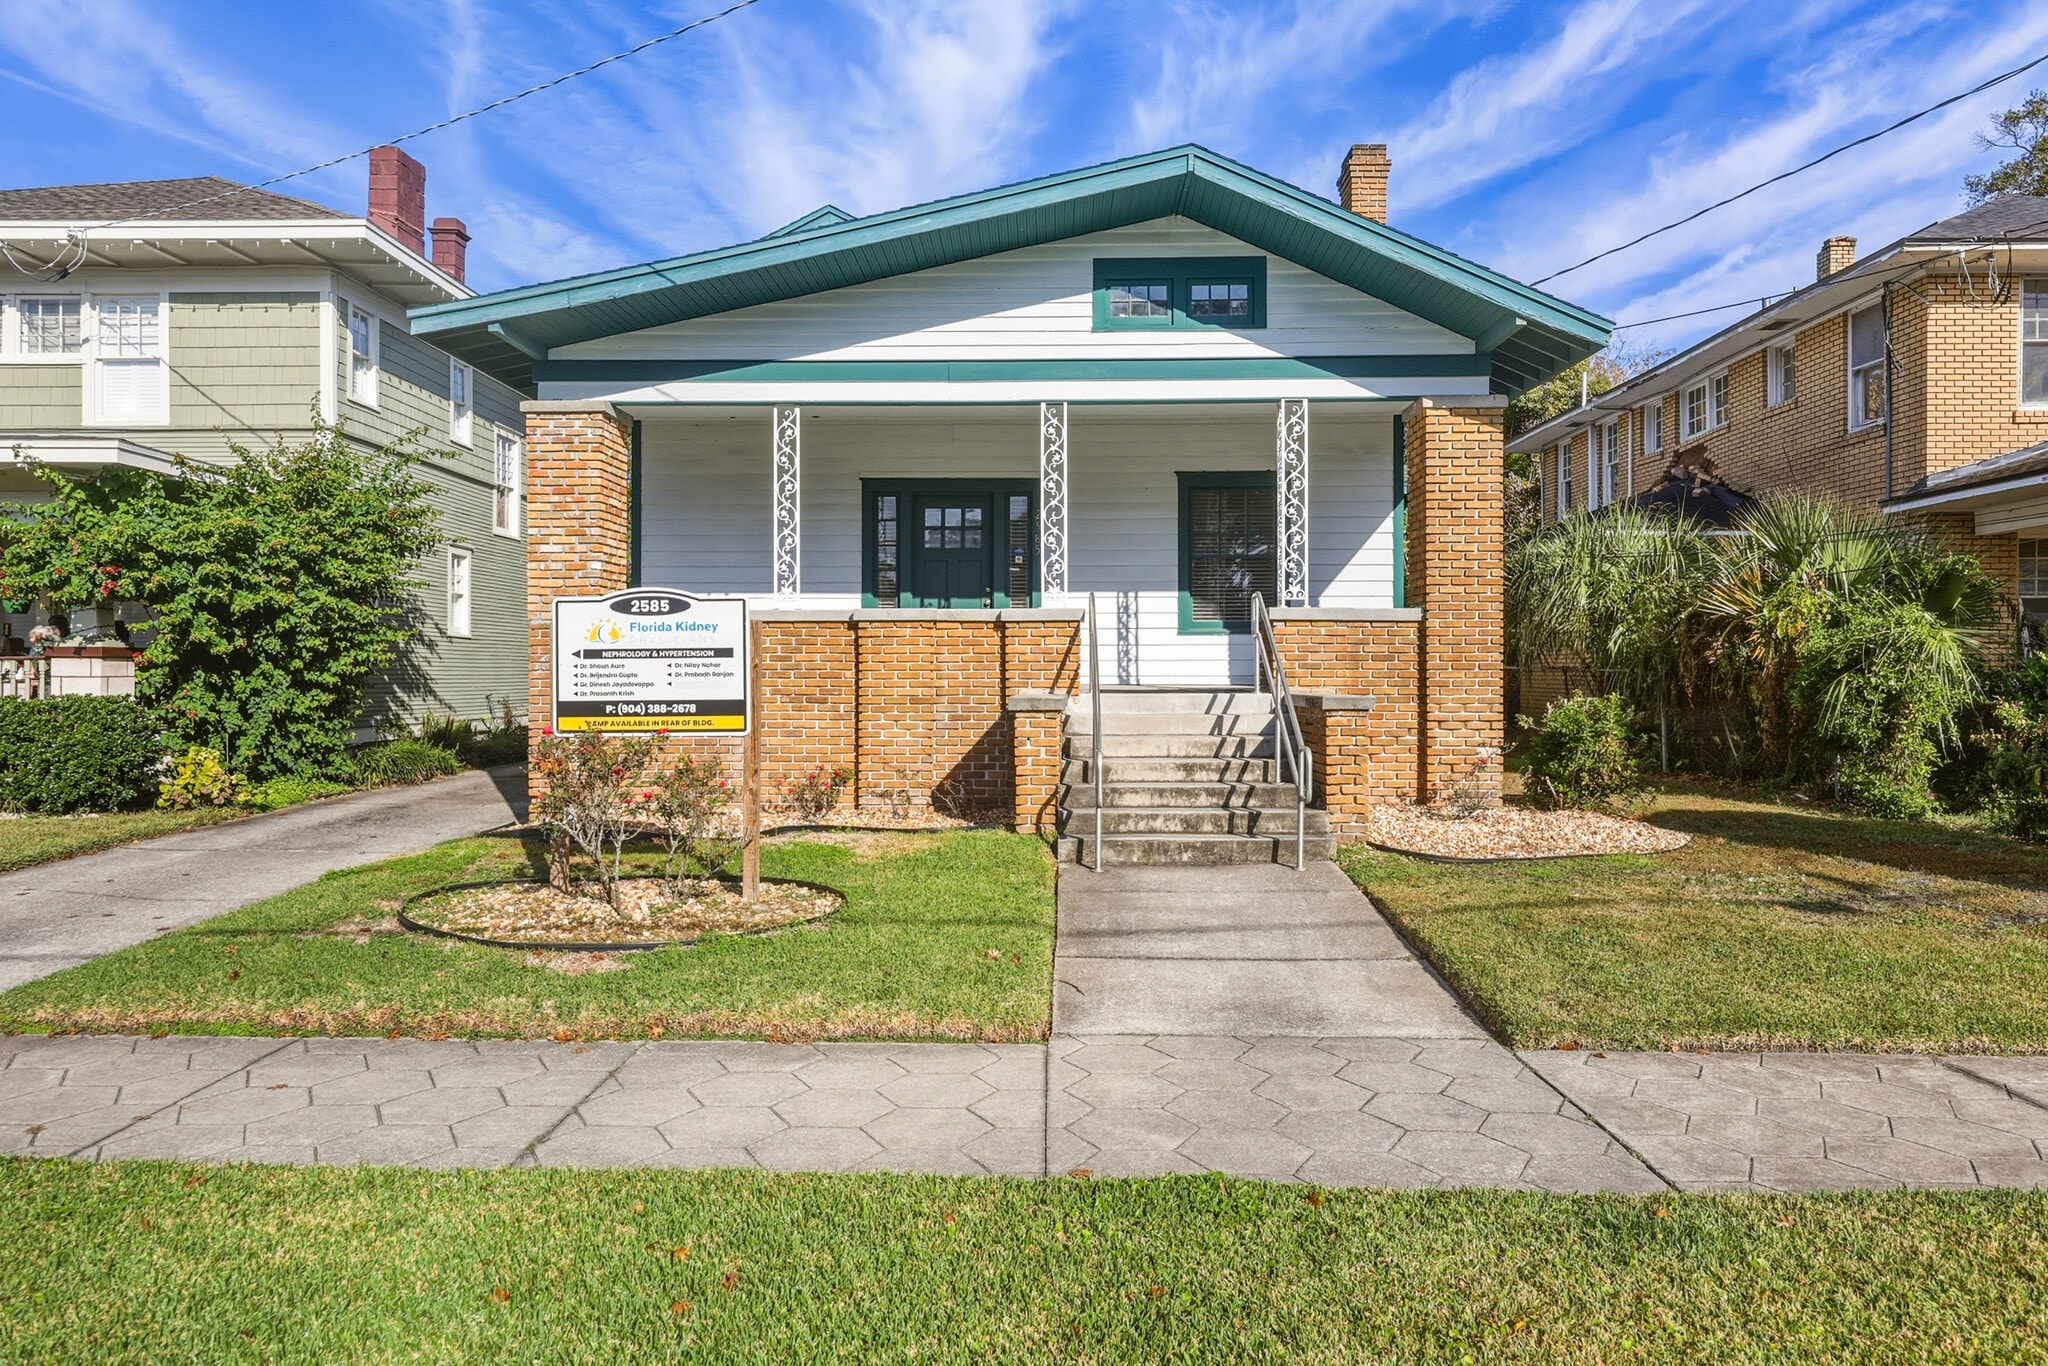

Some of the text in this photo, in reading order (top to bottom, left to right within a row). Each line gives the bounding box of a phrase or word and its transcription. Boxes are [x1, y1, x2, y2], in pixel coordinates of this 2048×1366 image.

[631, 600, 670, 613] 2585
[630, 621, 718, 633] Florida Kidney
[605, 703, 696, 715] P: (904) 388-2678
